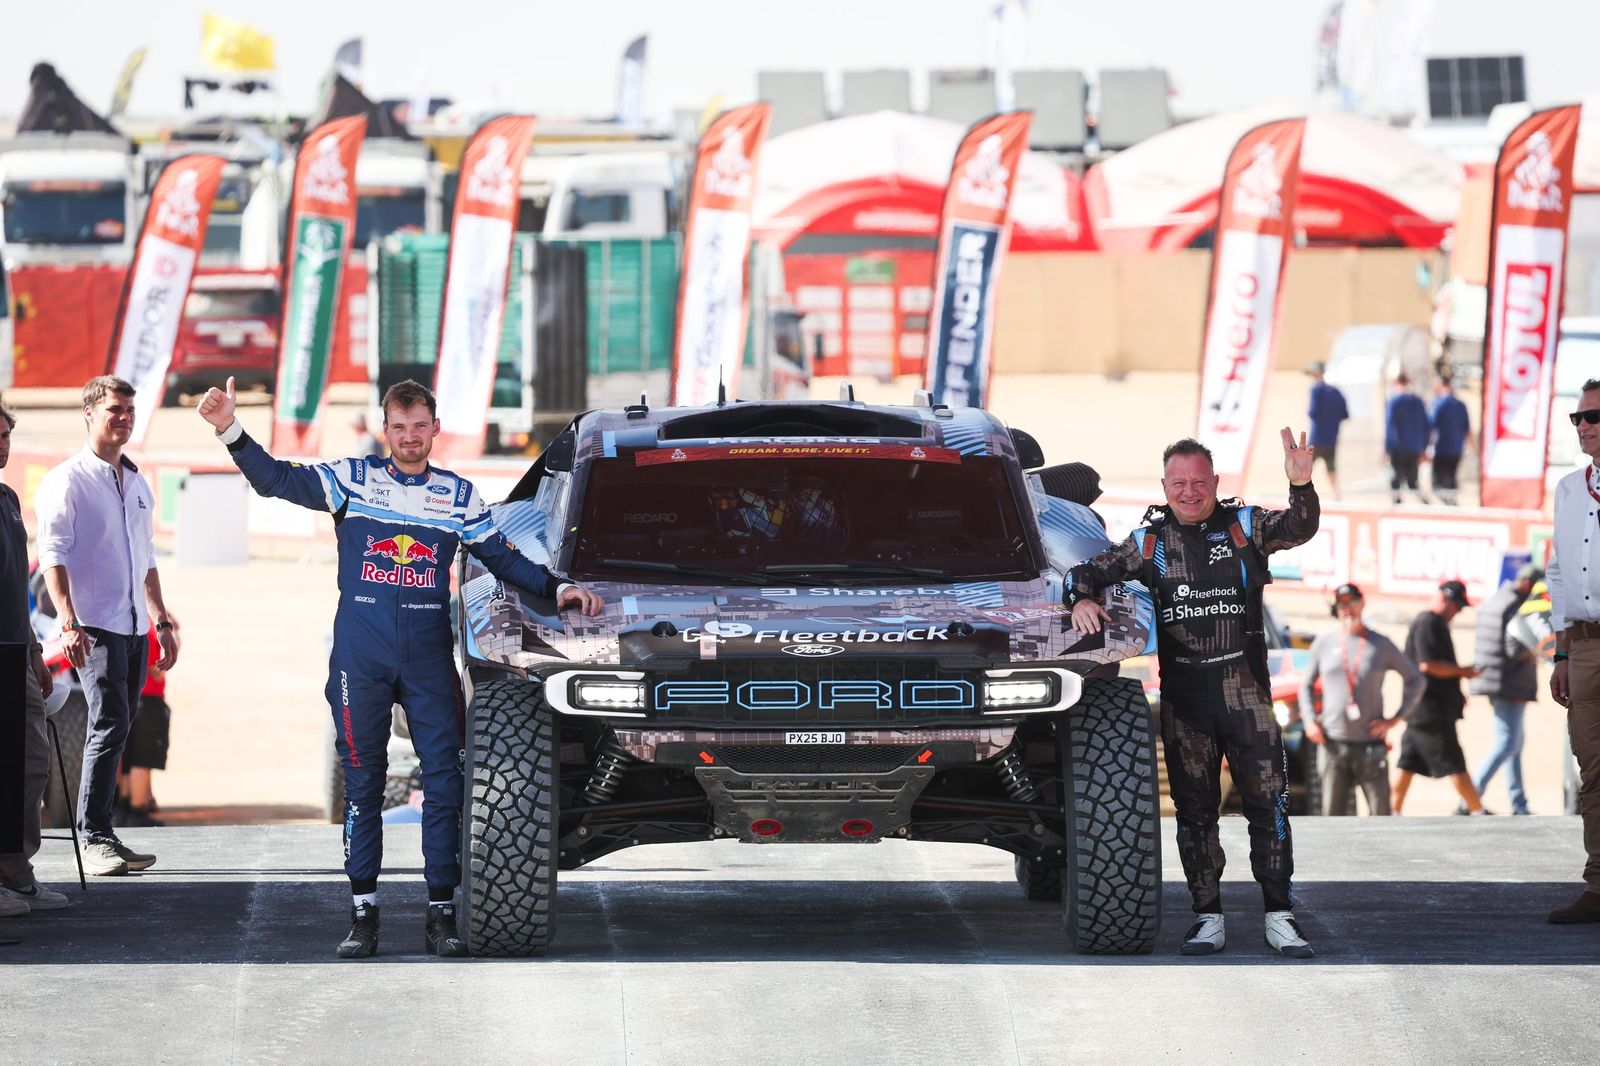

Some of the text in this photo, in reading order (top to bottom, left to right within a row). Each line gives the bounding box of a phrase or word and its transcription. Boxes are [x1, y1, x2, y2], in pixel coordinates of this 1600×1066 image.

[943, 232, 987, 410] EFENDER
[431, 497, 452, 506] Castrol
[624, 512, 677, 524] RECARO
[361, 561, 436, 588] Red Bull
[809, 587, 989, 597] Sharebox
[1189, 586, 1238, 599] Fleetback
[1176, 600, 1247, 620] Sharebox
[754, 625, 948, 644] Fleetback
[340, 670, 349, 706] FORD
[655, 680, 975, 710] FORD
[788, 733, 818, 744] PX25
